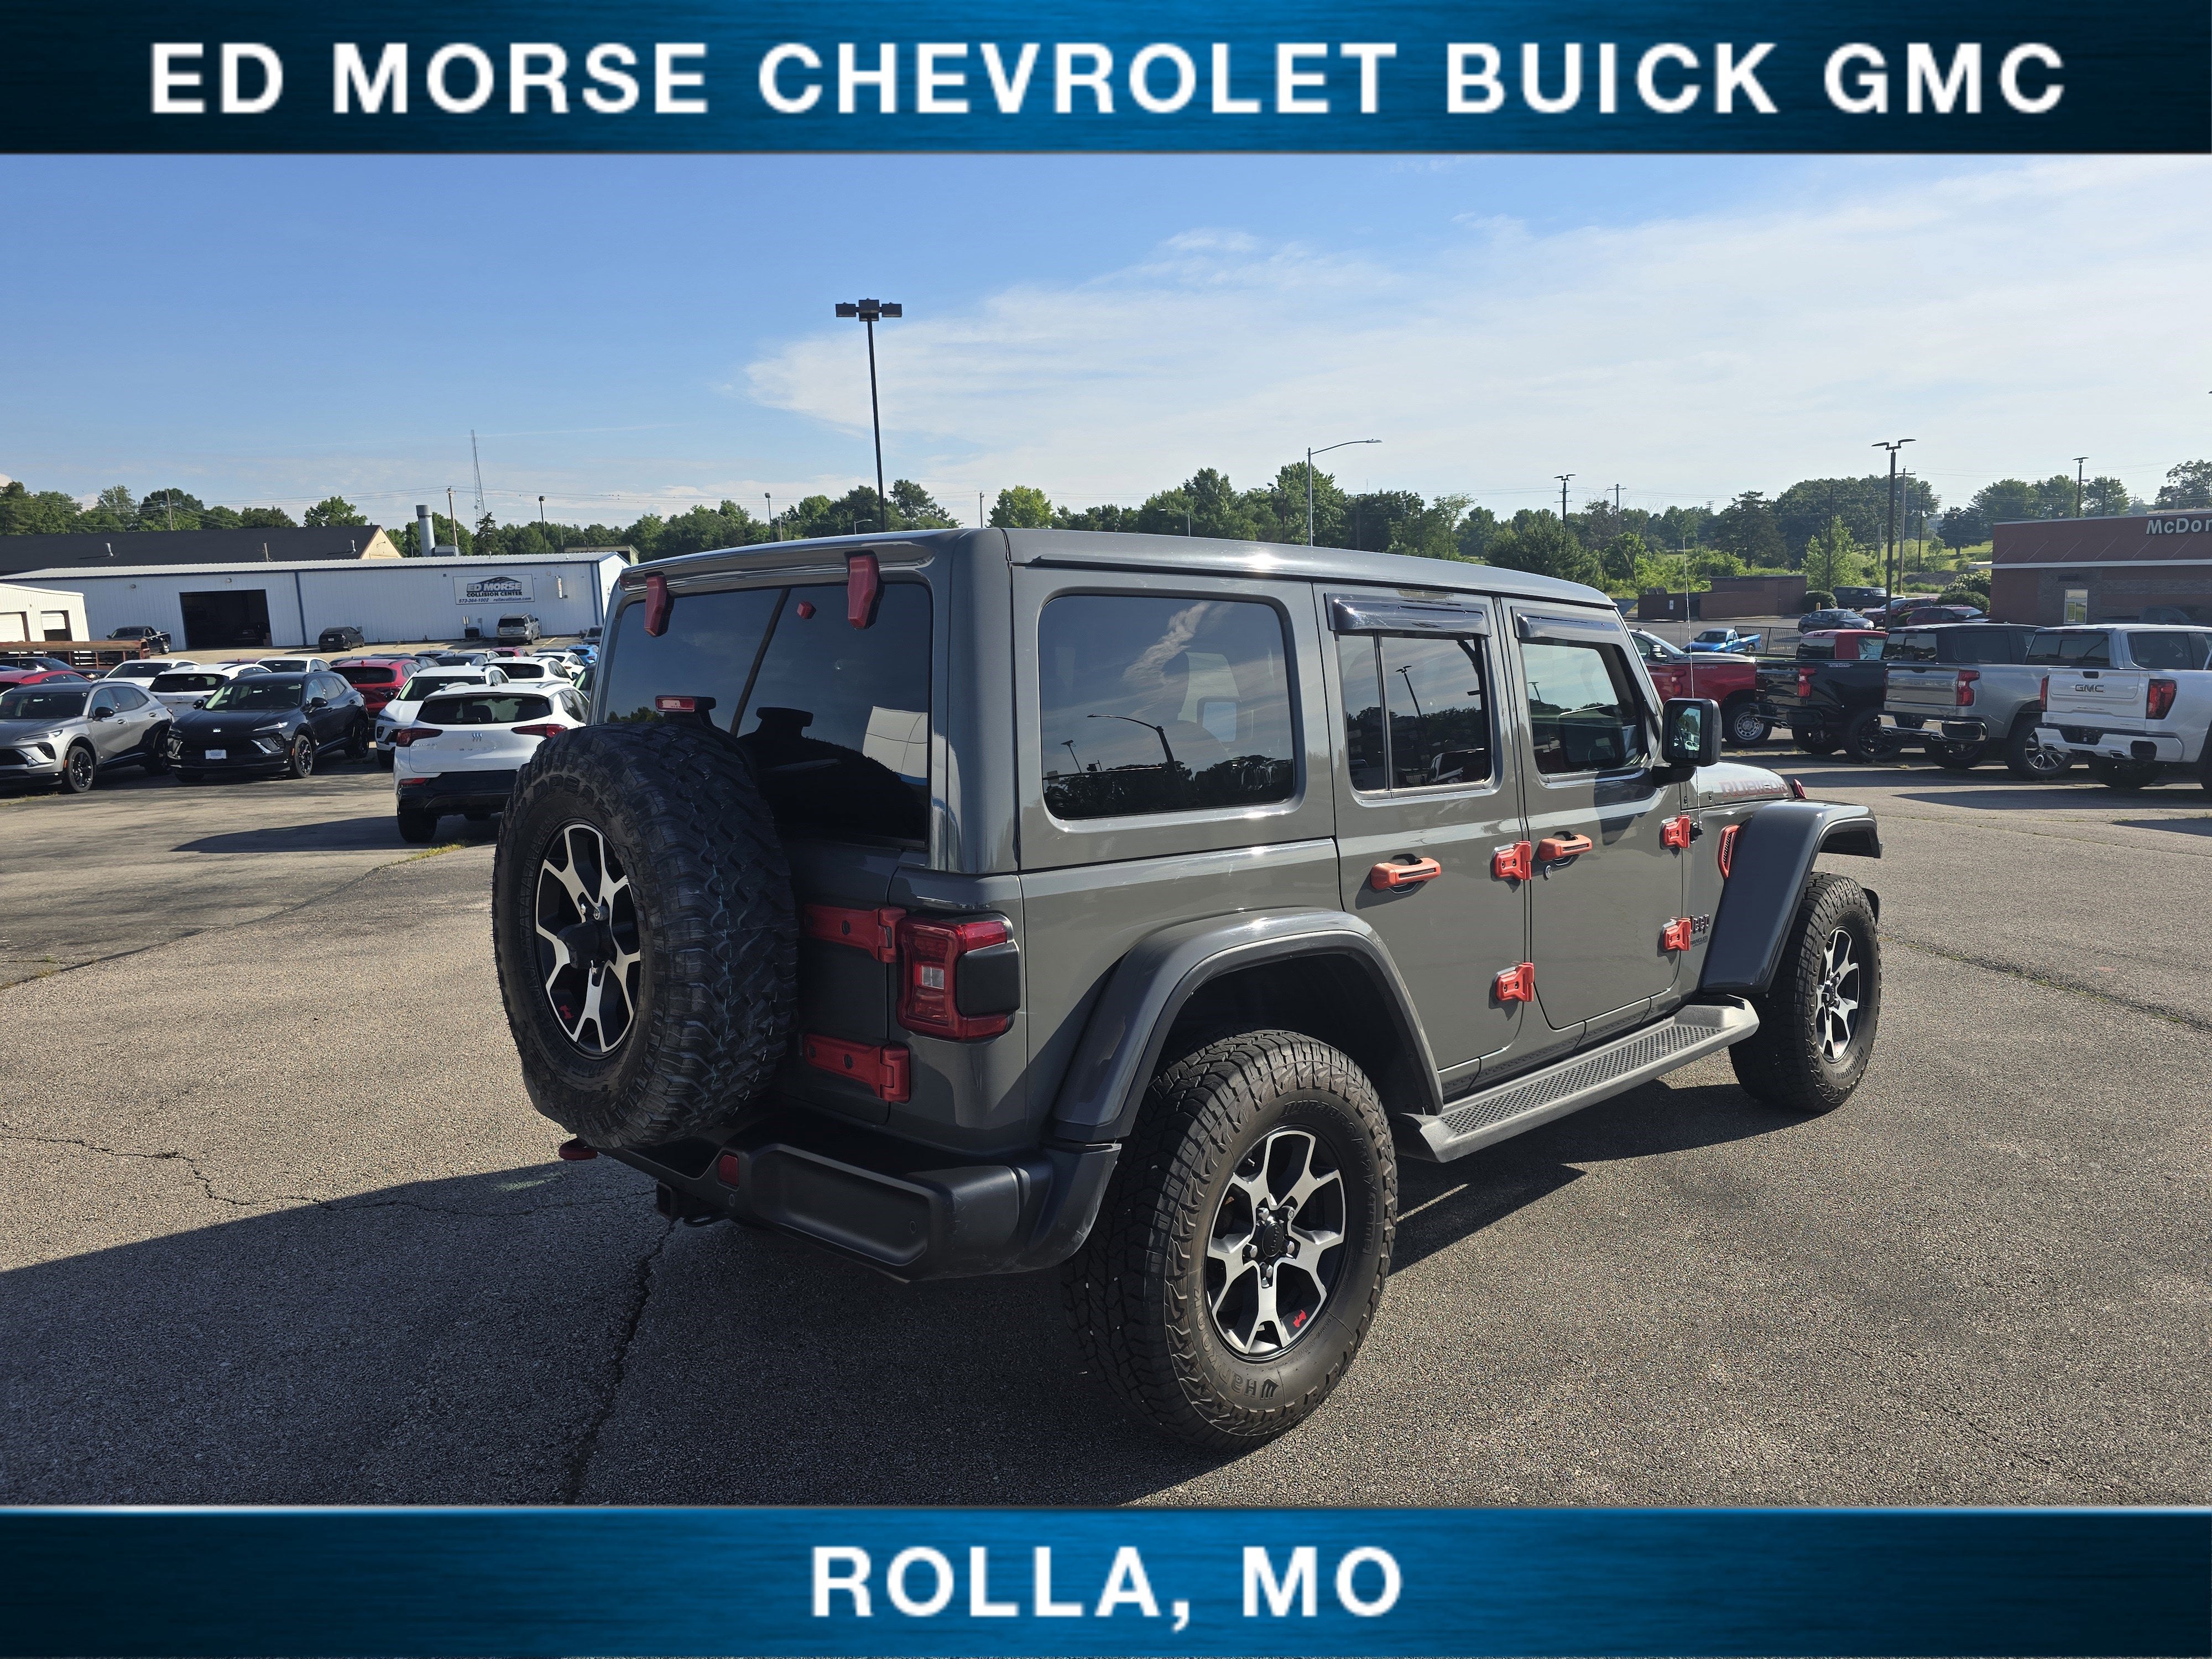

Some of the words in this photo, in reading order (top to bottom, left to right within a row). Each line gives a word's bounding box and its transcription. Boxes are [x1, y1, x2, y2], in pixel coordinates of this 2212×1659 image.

[467, 583, 482, 592] ED
[483, 582, 522, 592] MORSE
[2075, 684, 2105, 692] GMC
[1719, 779, 1789, 797] RUBICON
